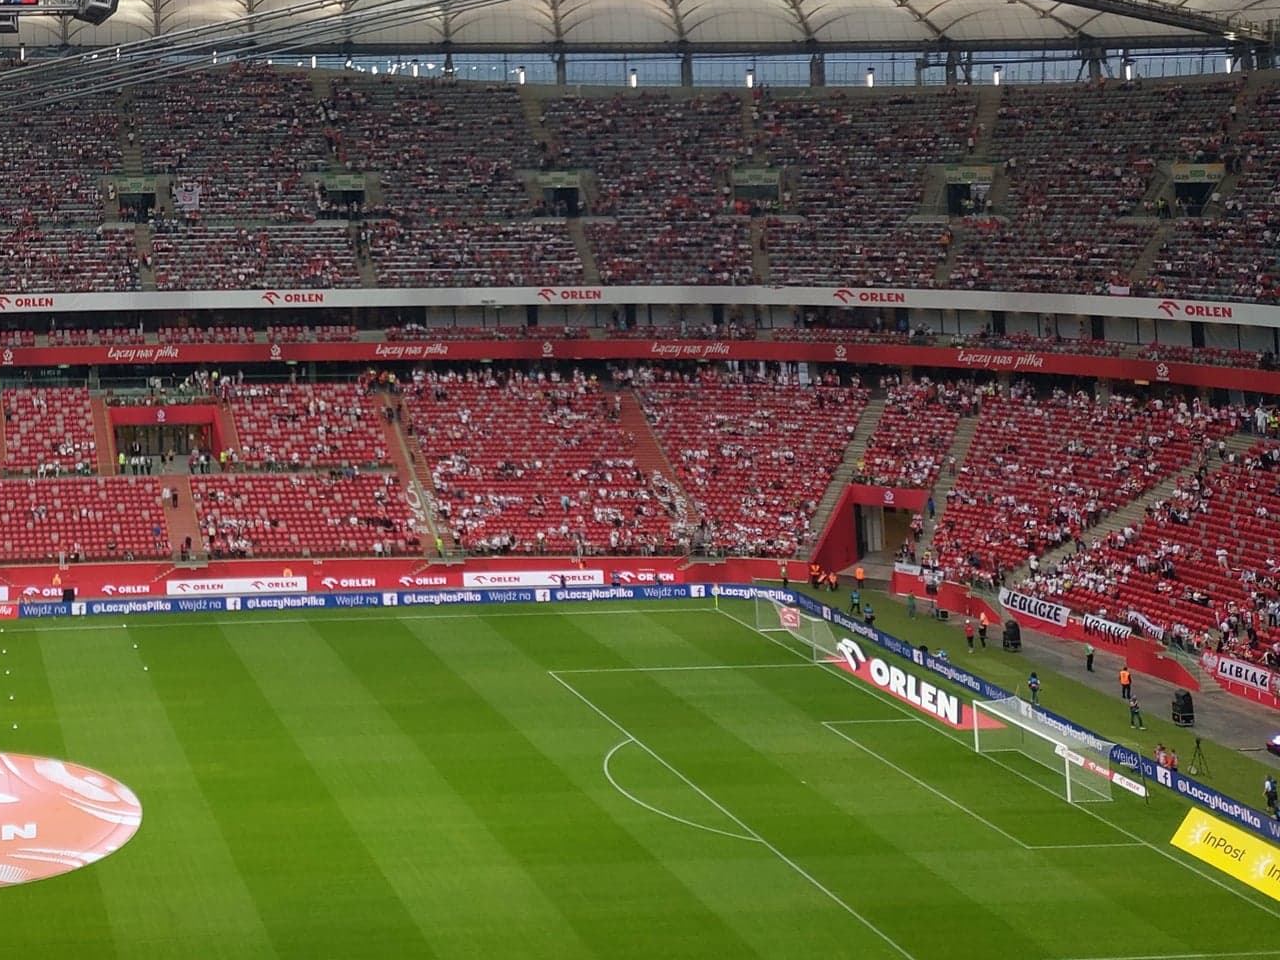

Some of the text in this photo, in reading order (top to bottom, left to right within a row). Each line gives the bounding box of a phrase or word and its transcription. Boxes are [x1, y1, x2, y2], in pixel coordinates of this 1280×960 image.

[285, 294, 323, 302] ORLEN
[561, 290, 601, 299] ORLEN
[860, 292, 904, 303] ORLEN
[15, 298, 53, 307] ORLEN
[1185, 305, 1232, 318] ORLEN
[376, 342, 448, 358] Łączy nas piłka
[651, 341, 729, 356] Łączy nas piłka
[108, 346, 178, 361] Łączy nas piłka
[958, 351, 1043, 368] Łączy nas piłka
[340, 578, 376, 587] ORLEN
[414, 577, 446, 585] ORLEN
[42, 586, 78, 596] ORLN
[118, 585, 150, 593] ORLEN
[673, 588, 685, 596] na
[365, 596, 377, 605] na
[519, 592, 531, 600] na
[54, 605, 66, 614] na
[209, 601, 221, 609] na
[1004, 591, 1062, 622] JEDLICZE
[870, 658, 958, 724] ORLEN
[1203, 832, 1246, 861] InPost
